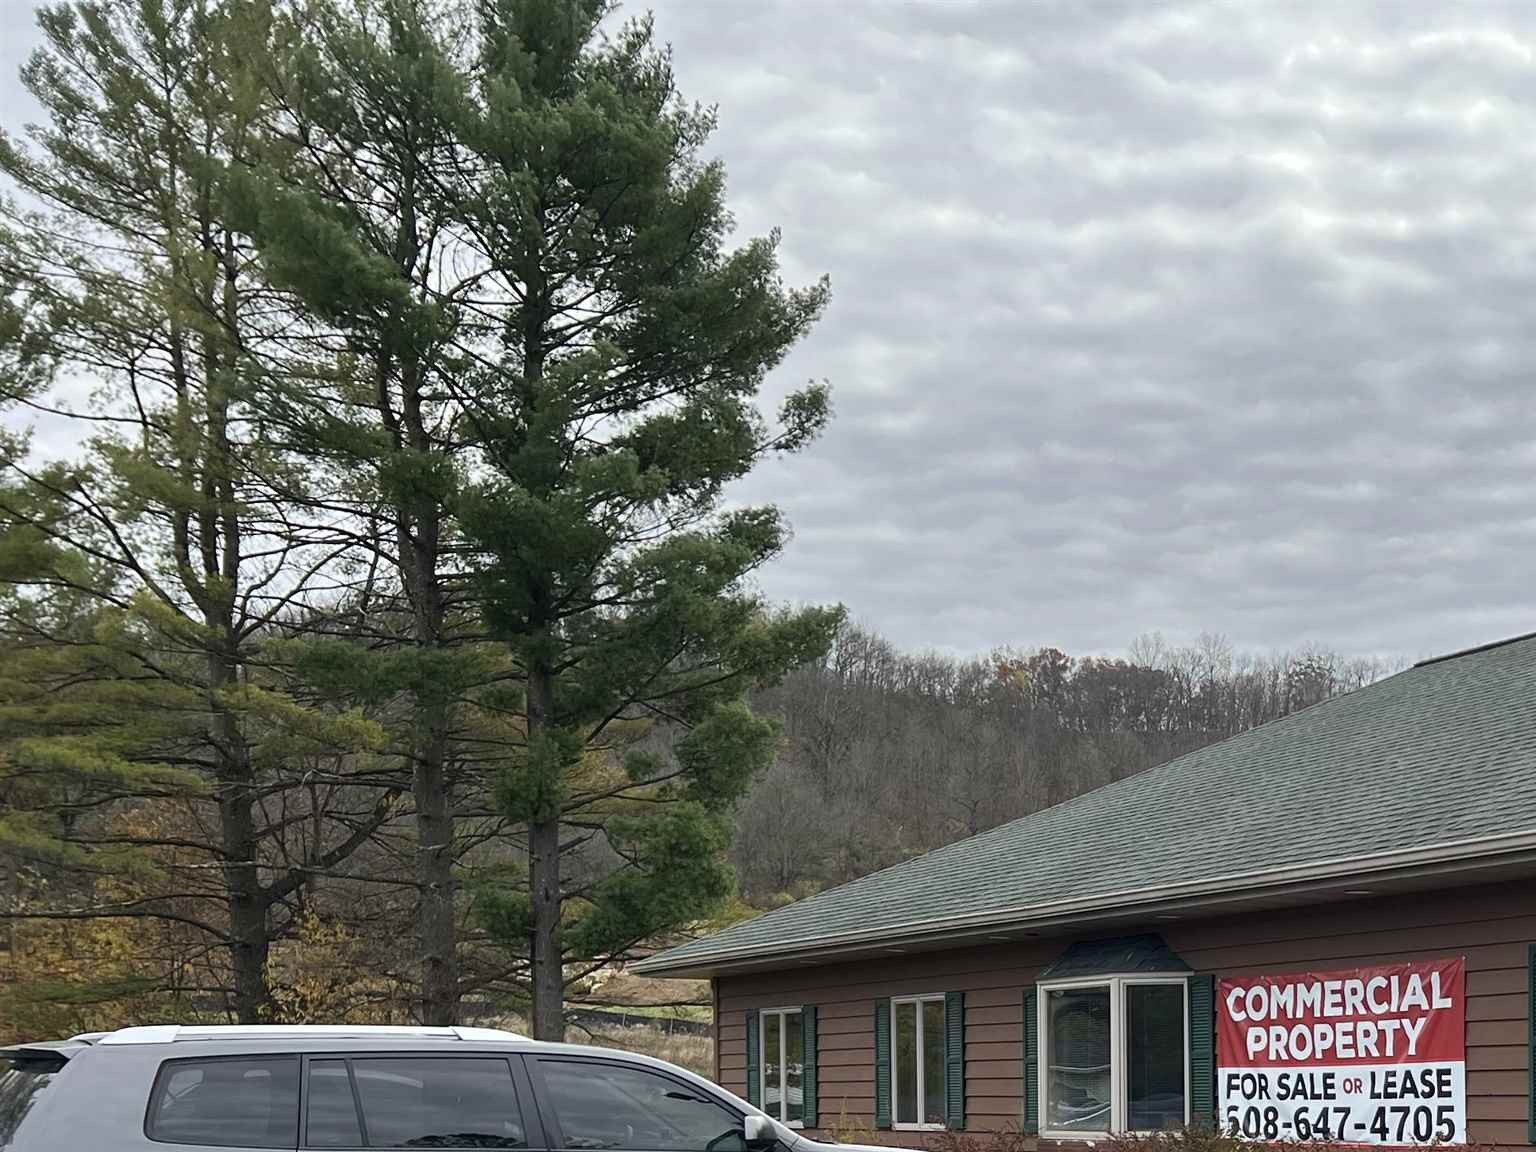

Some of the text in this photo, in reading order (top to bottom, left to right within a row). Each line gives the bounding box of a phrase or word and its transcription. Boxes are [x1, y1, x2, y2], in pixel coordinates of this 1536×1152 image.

[1226, 971, 1452, 1022] COMMERCIAL
[1246, 1017, 1427, 1061] PROPERTY
[1226, 1068, 1452, 1101] FOR SALE OR LEASE
